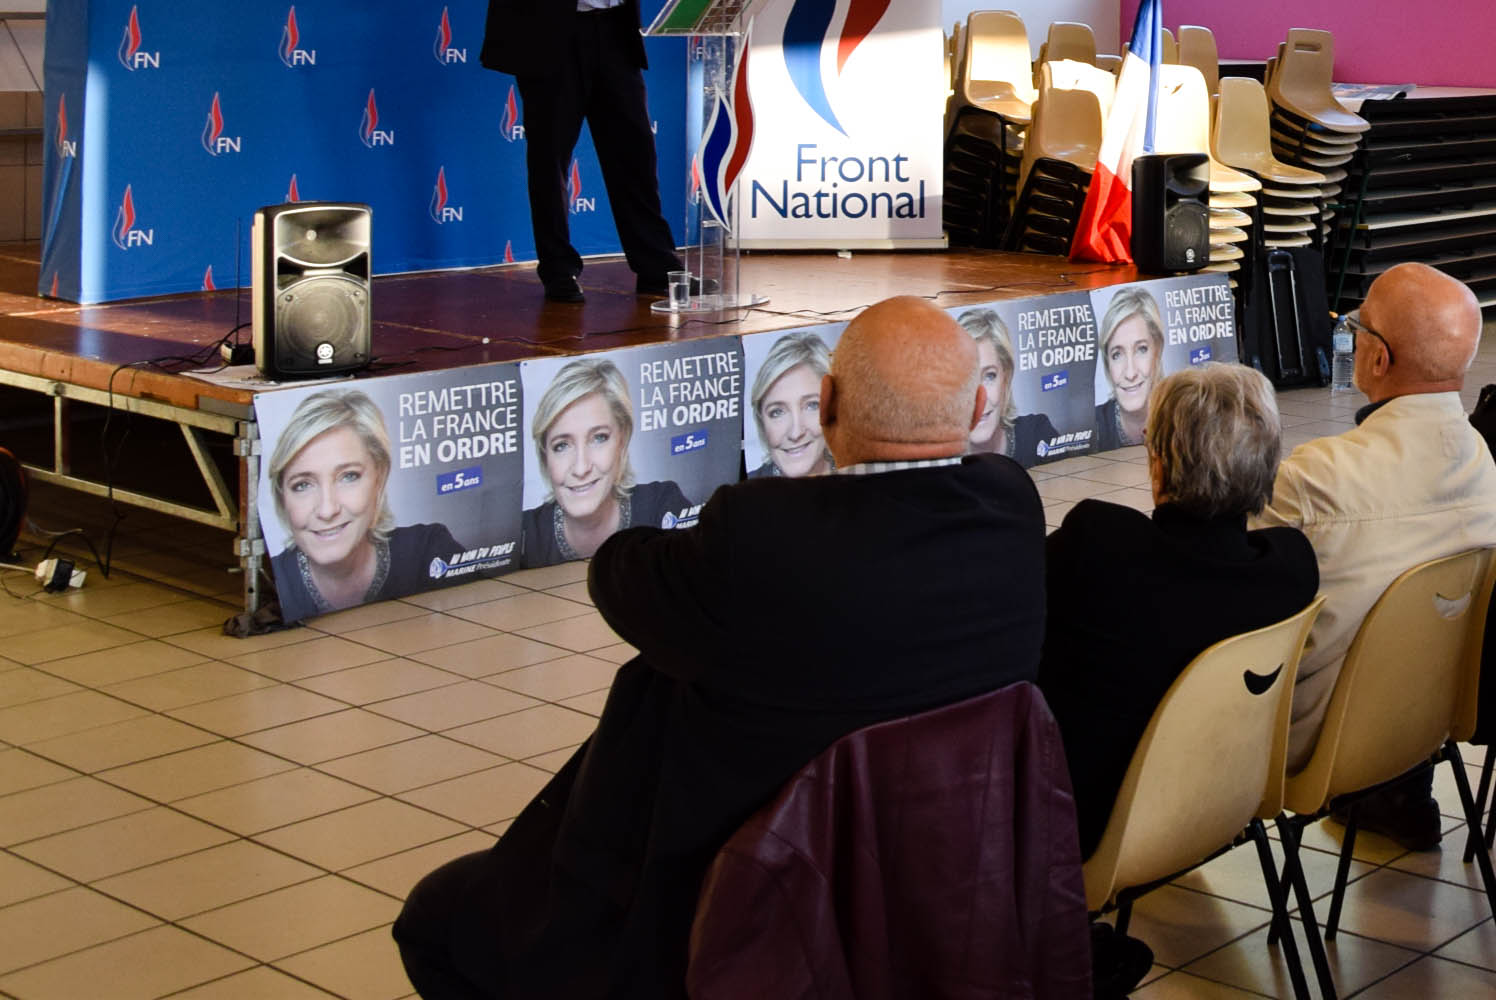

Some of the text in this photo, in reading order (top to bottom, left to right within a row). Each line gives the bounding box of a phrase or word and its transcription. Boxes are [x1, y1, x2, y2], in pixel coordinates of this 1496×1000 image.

[134, 52, 161, 69] FN
[292, 49, 316, 66] FN
[445, 48, 467, 64] FN
[62, 140, 77, 158] FN
[216, 137, 242, 153] FN
[371, 130, 395, 146] FN
[797, 144, 910, 183] Front
[576, 198, 596, 212] FN
[751, 179, 925, 219] National
[441, 206, 464, 223] FN
[127, 229, 154, 247] FN
[1165, 284, 1231, 308] REMETTRE
[1018, 304, 1093, 331] REMETTRE
[1167, 303, 1232, 327] LA FRANCE
[1019, 324, 1095, 351] LA FRANCE
[1168, 321, 1233, 345] EN ORDRE
[640, 351, 740, 385] REMETTRE
[1019, 343, 1095, 371] EN ORDRE
[400, 380, 518, 417] REMETTRE
[640, 375, 740, 408] LA FRANCE
[400, 406, 518, 442] LA FRANCE
[640, 397, 739, 432] EN ORDRE
[400, 430, 518, 469] EN ORDRE
[674, 435, 706, 453] en 5 ans
[441, 472, 480, 492] en 5 ans
